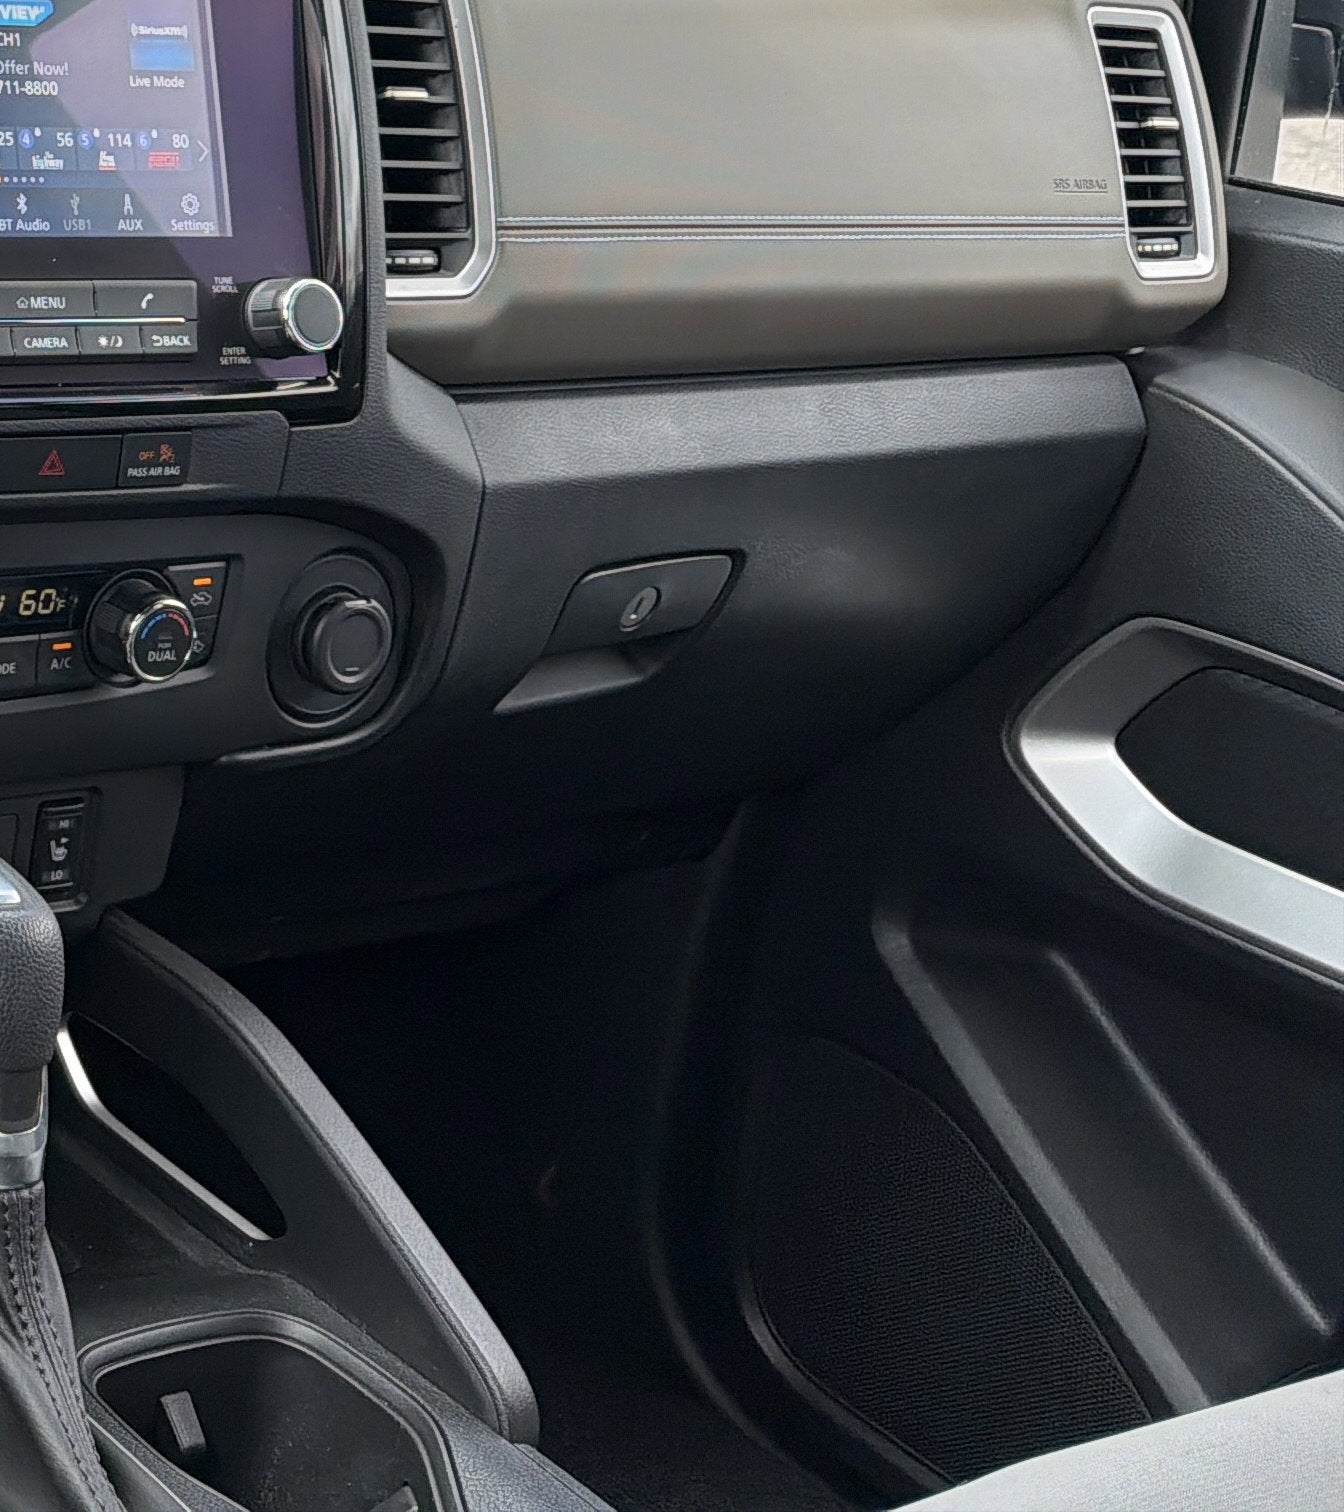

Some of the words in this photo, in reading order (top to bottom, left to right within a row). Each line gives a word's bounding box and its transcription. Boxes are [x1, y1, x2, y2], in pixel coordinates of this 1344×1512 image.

[33, 61, 70, 76] Now!
[129, 75, 151, 88] Live
[153, 75, 186, 88] Mode
[56, 132, 75, 148] 56
[107, 133, 133, 148] 114
[171, 133, 191, 149] 80
[16, 218, 51, 232] Audio
[63, 219, 92, 232] USB1
[117, 218, 144, 232] AUX
[171, 219, 216, 235] Settings
[214, 276, 234, 286] TUNE
[211, 284, 239, 294] SCROLL
[30, 296, 67, 310] MENU
[23, 336, 69, 349] CAMERA
[162, 334, 192, 347] BACK
[222, 346, 247, 356] ENTER
[219, 355, 252, 366] SETTING
[139, 450, 156, 462] OFF
[127, 466, 149, 478] PASS
[148, 466, 164, 477] AIR
[163, 465, 182, 476] BAG
[147, 650, 177, 662] DUAL
[50, 656, 72, 670] A/C
[59, 820, 70, 829] HI
[51, 869, 63, 881] LO
